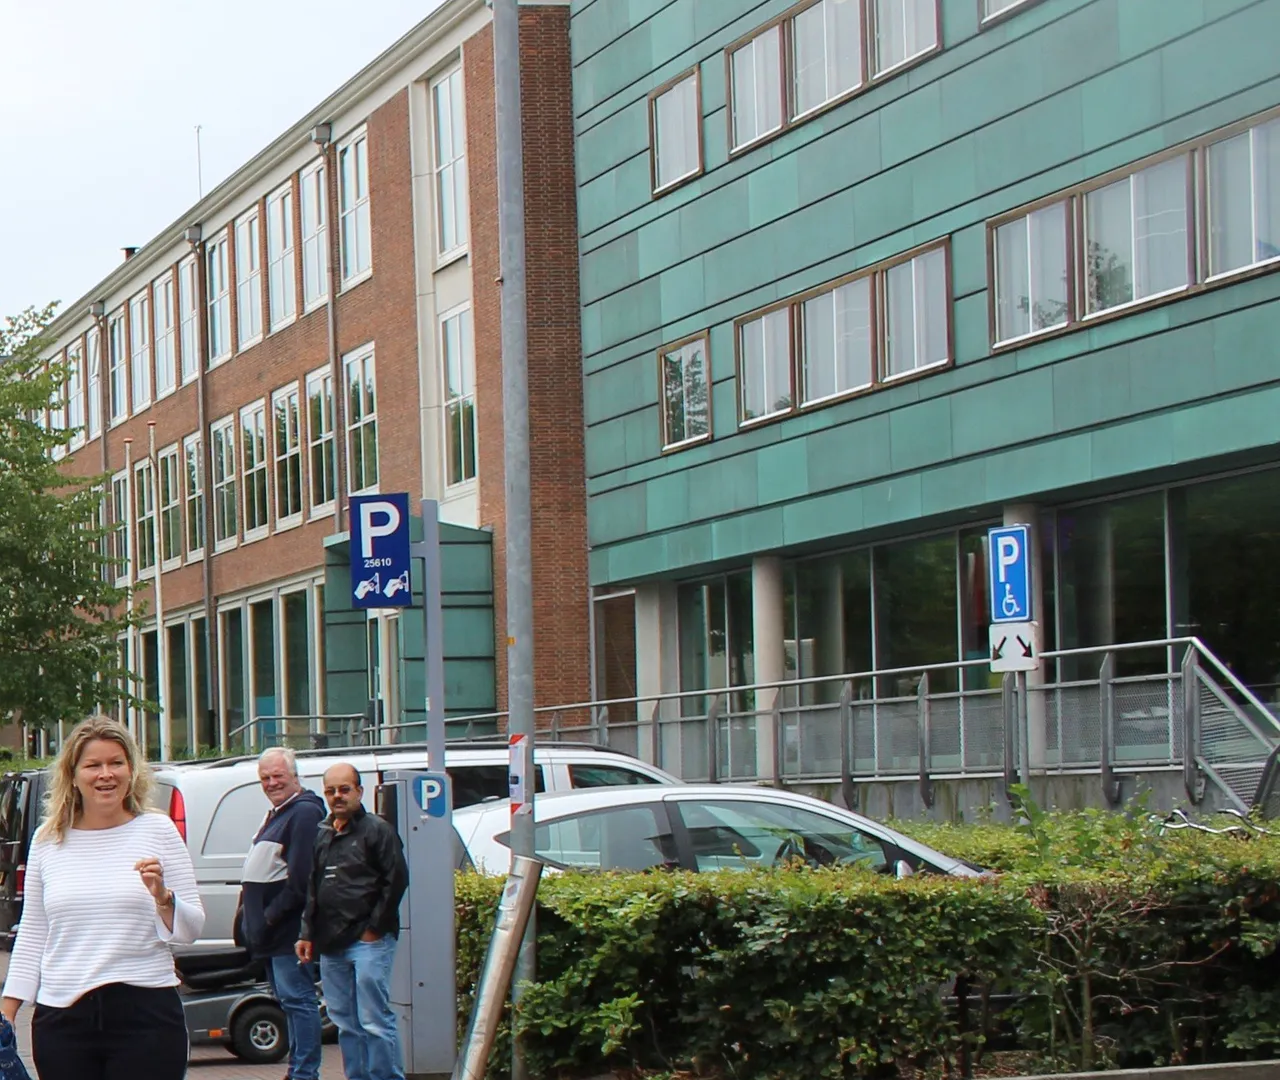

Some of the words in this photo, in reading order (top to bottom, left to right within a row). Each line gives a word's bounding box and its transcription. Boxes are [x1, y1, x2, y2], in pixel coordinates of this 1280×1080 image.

[360, 501, 401, 558] P
[363, 558, 392, 568] 25610
[997, 535, 1020, 582] P
[420, 779, 442, 810] P
